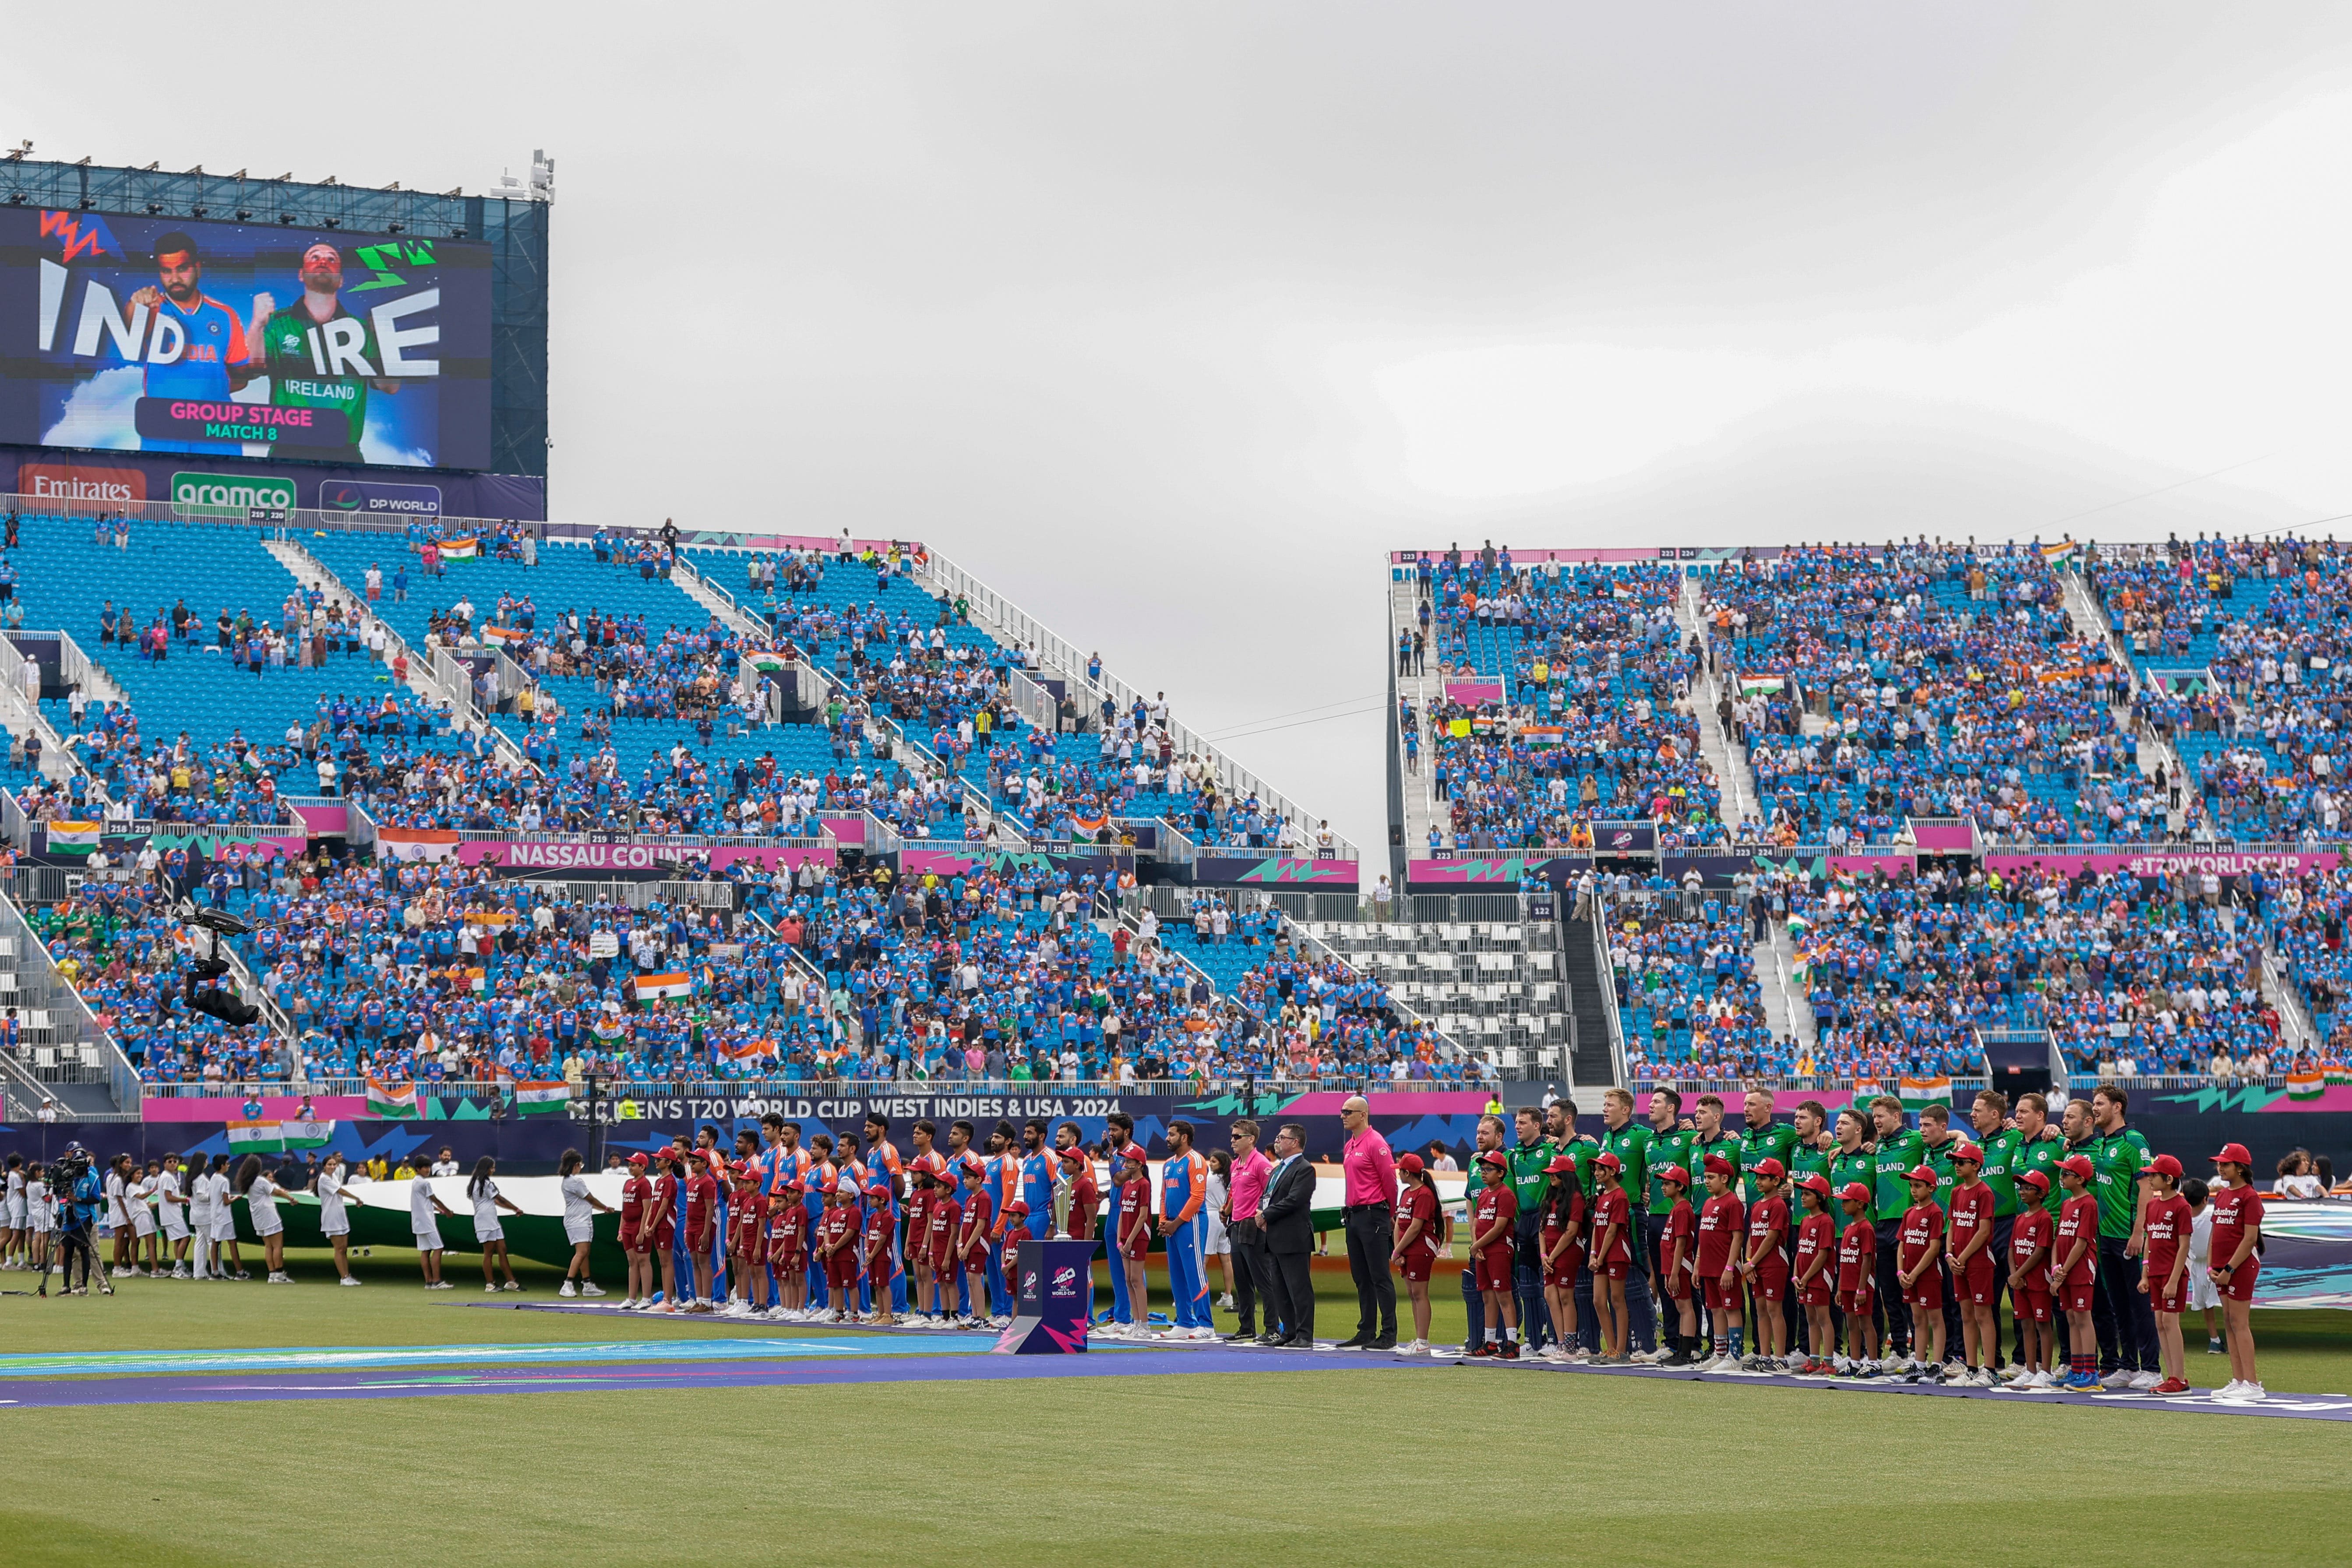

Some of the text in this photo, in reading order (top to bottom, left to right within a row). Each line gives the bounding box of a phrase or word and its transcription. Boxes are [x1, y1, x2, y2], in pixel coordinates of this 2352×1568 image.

[39, 257, 185, 365] IND
[307, 287, 439, 377] IRE
[285, 378, 356, 401] IRELAND
[170, 402, 312, 427] GROUP STAGE
[205, 423, 278, 441] MATCH 8
[34, 476, 131, 501] Emirates
[177, 483, 290, 508] aramco
[369, 499, 437, 512] DP WORLD
[592, 835, 607, 843] 219
[511, 845, 607, 866] NASSAU
[687, 1100, 727, 1119] T20
[817, 1101, 862, 1119] CUP
[868, 1099, 929, 1117] WEST
[935, 1099, 1003, 1117] INDIES
[1007, 1099, 1021, 1117] &
[1025, 1099, 1065, 1117] USA
[1072, 1099, 1120, 1117] 2024
[1957, 1218, 1974, 1227] Bank
[2216, 1216, 2235, 1225] Bank
[1906, 1236, 1925, 1246] Bank
[2152, 1231, 2172, 1240] Bank
[1799, 1246, 1814, 1254] Bank
[2016, 1246, 2033, 1256] Bank
[1840, 1255, 1857, 1263] Bank
